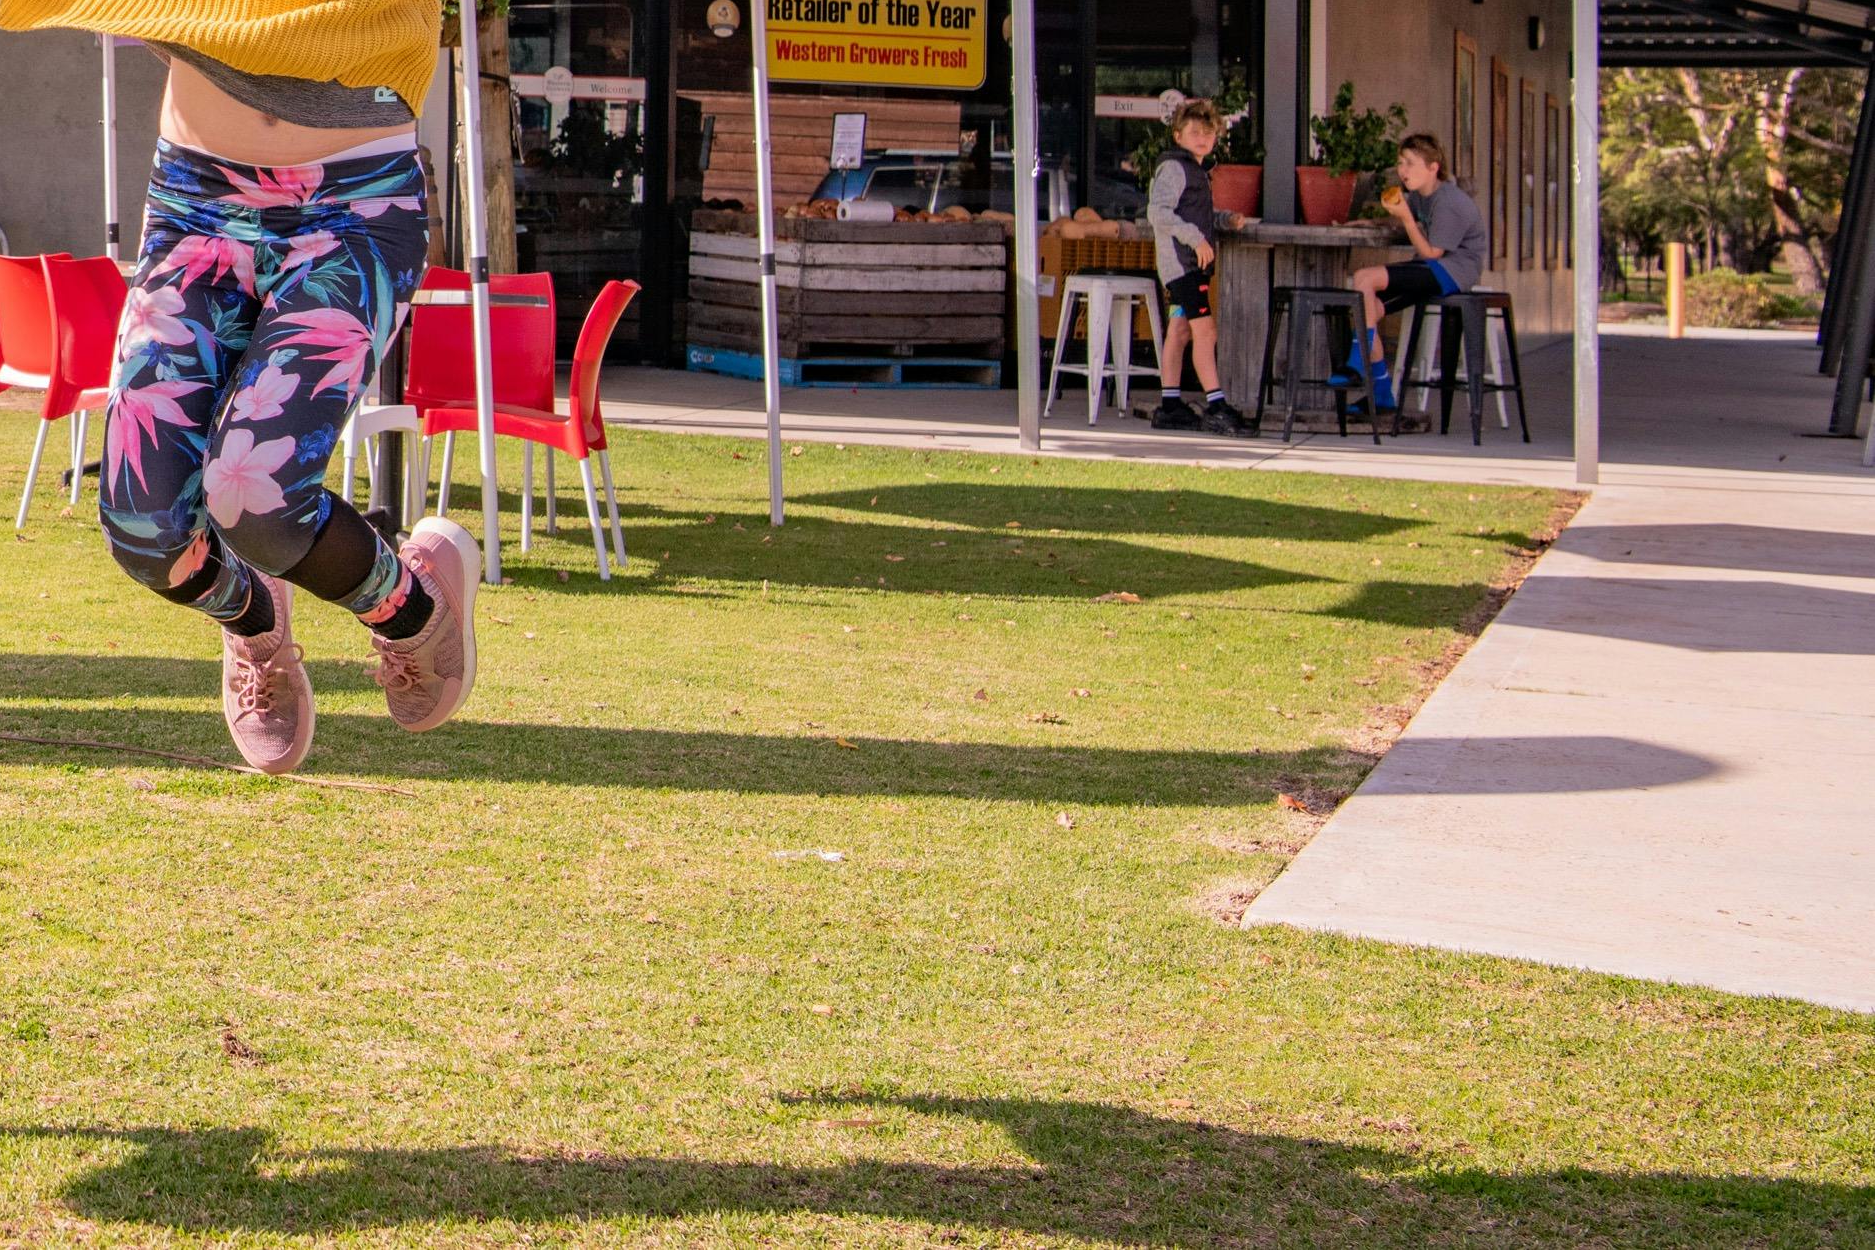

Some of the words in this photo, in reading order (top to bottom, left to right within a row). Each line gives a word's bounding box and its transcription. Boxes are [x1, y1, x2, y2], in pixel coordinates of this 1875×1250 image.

[927, 0, 976, 30] Year
[775, 38, 845, 63] Western
[849, 41, 920, 67] Growers
[923, 45, 968, 69] Fresh
[590, 82, 633, 95] Welcome
[1114, 100, 1134, 111] Exit
